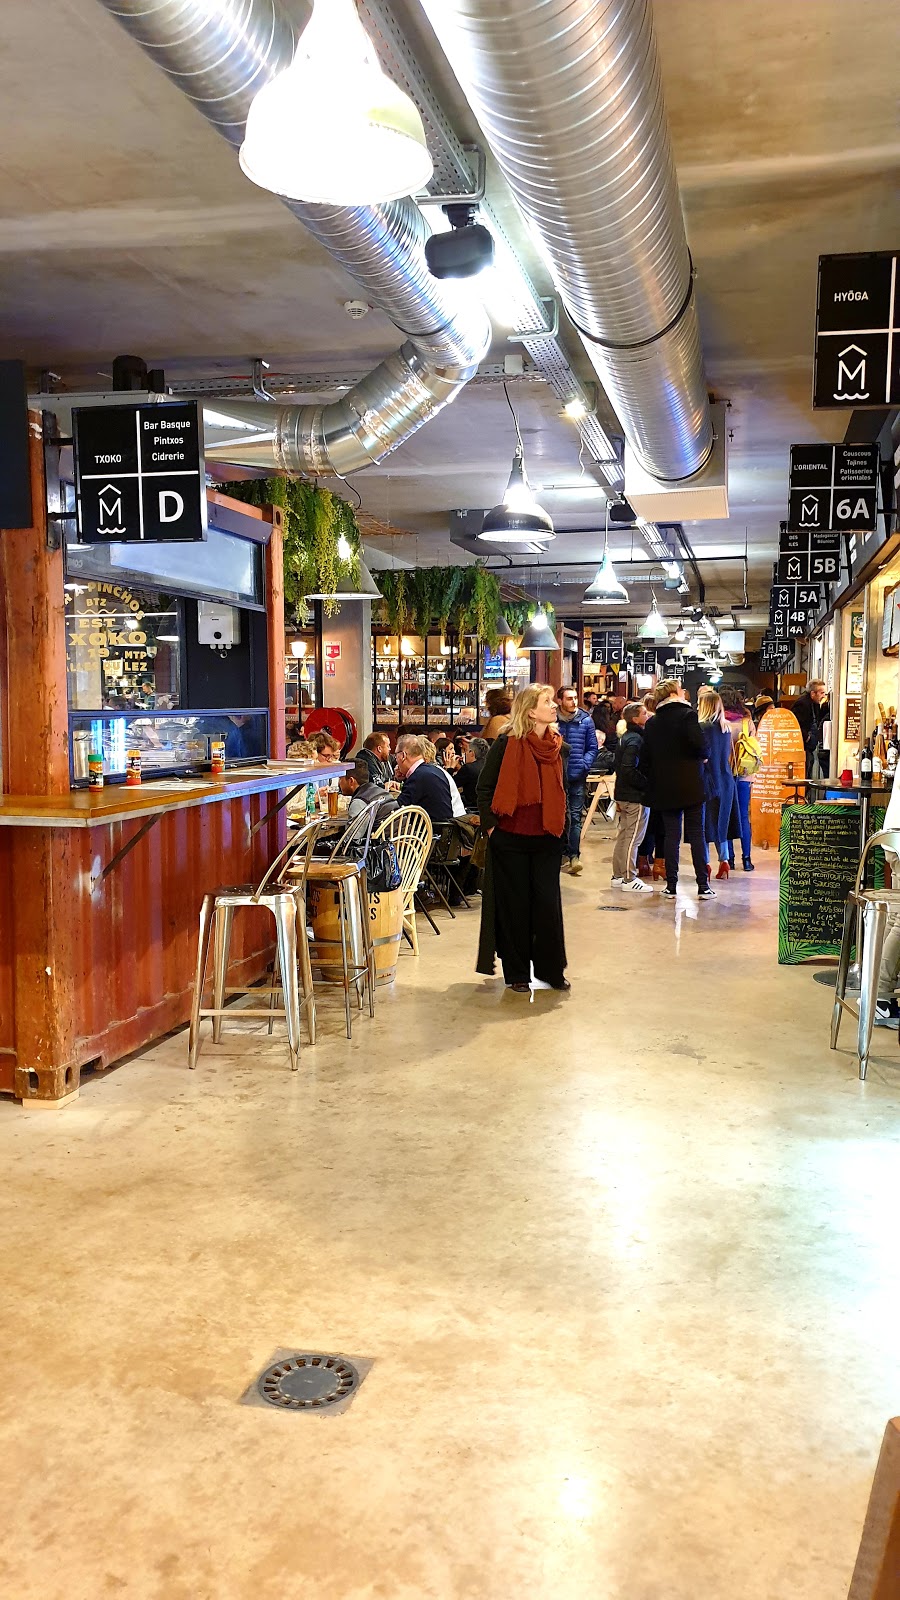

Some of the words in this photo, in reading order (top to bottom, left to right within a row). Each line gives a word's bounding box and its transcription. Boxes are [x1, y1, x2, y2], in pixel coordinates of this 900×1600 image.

[833, 290, 869, 302] HYŌGA
[143, 421, 158, 430] Bar
[160, 420, 191, 430] Basque
[153, 436, 184, 445] Pintxos
[94, 454, 122, 464] TXOKO
[151, 451, 185, 462] Cidrerie
[793, 463, 829, 471] L'ORIENTAL
[846, 459, 868, 467] Tajines
[158, 490, 184, 523] D
[836, 497, 870, 520] 6A
[813, 557, 836, 574] 5B
[87, 581, 145, 621] PINCHOS
[798, 590, 818, 603] 5A
[86, 597, 107, 607] BTZ
[789, 611, 806, 622] 4B
[78, 618, 116, 628] EST
[789, 626, 804, 634] 4A
[68, 630, 147, 647] XOKO
[124, 650, 148, 660] MTP
[611, 650, 619, 660] C
[124, 661, 148, 672] LEZ
